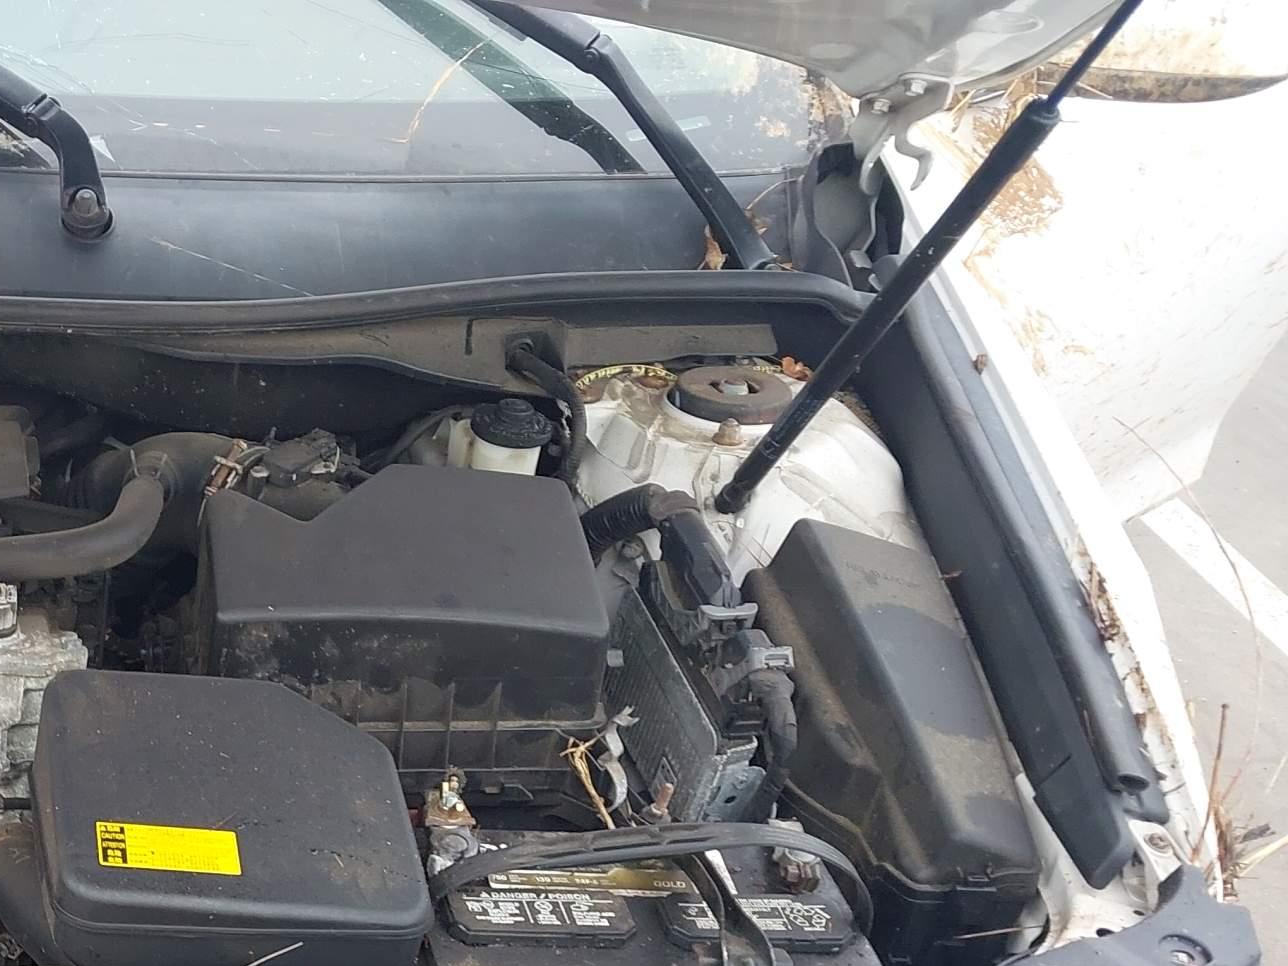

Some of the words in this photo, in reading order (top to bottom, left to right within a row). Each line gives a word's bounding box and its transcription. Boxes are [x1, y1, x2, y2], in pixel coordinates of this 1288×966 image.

[653, 880, 687, 889] GOLD
[490, 891, 537, 901] DANGER
[548, 892, 591, 902] POISON
